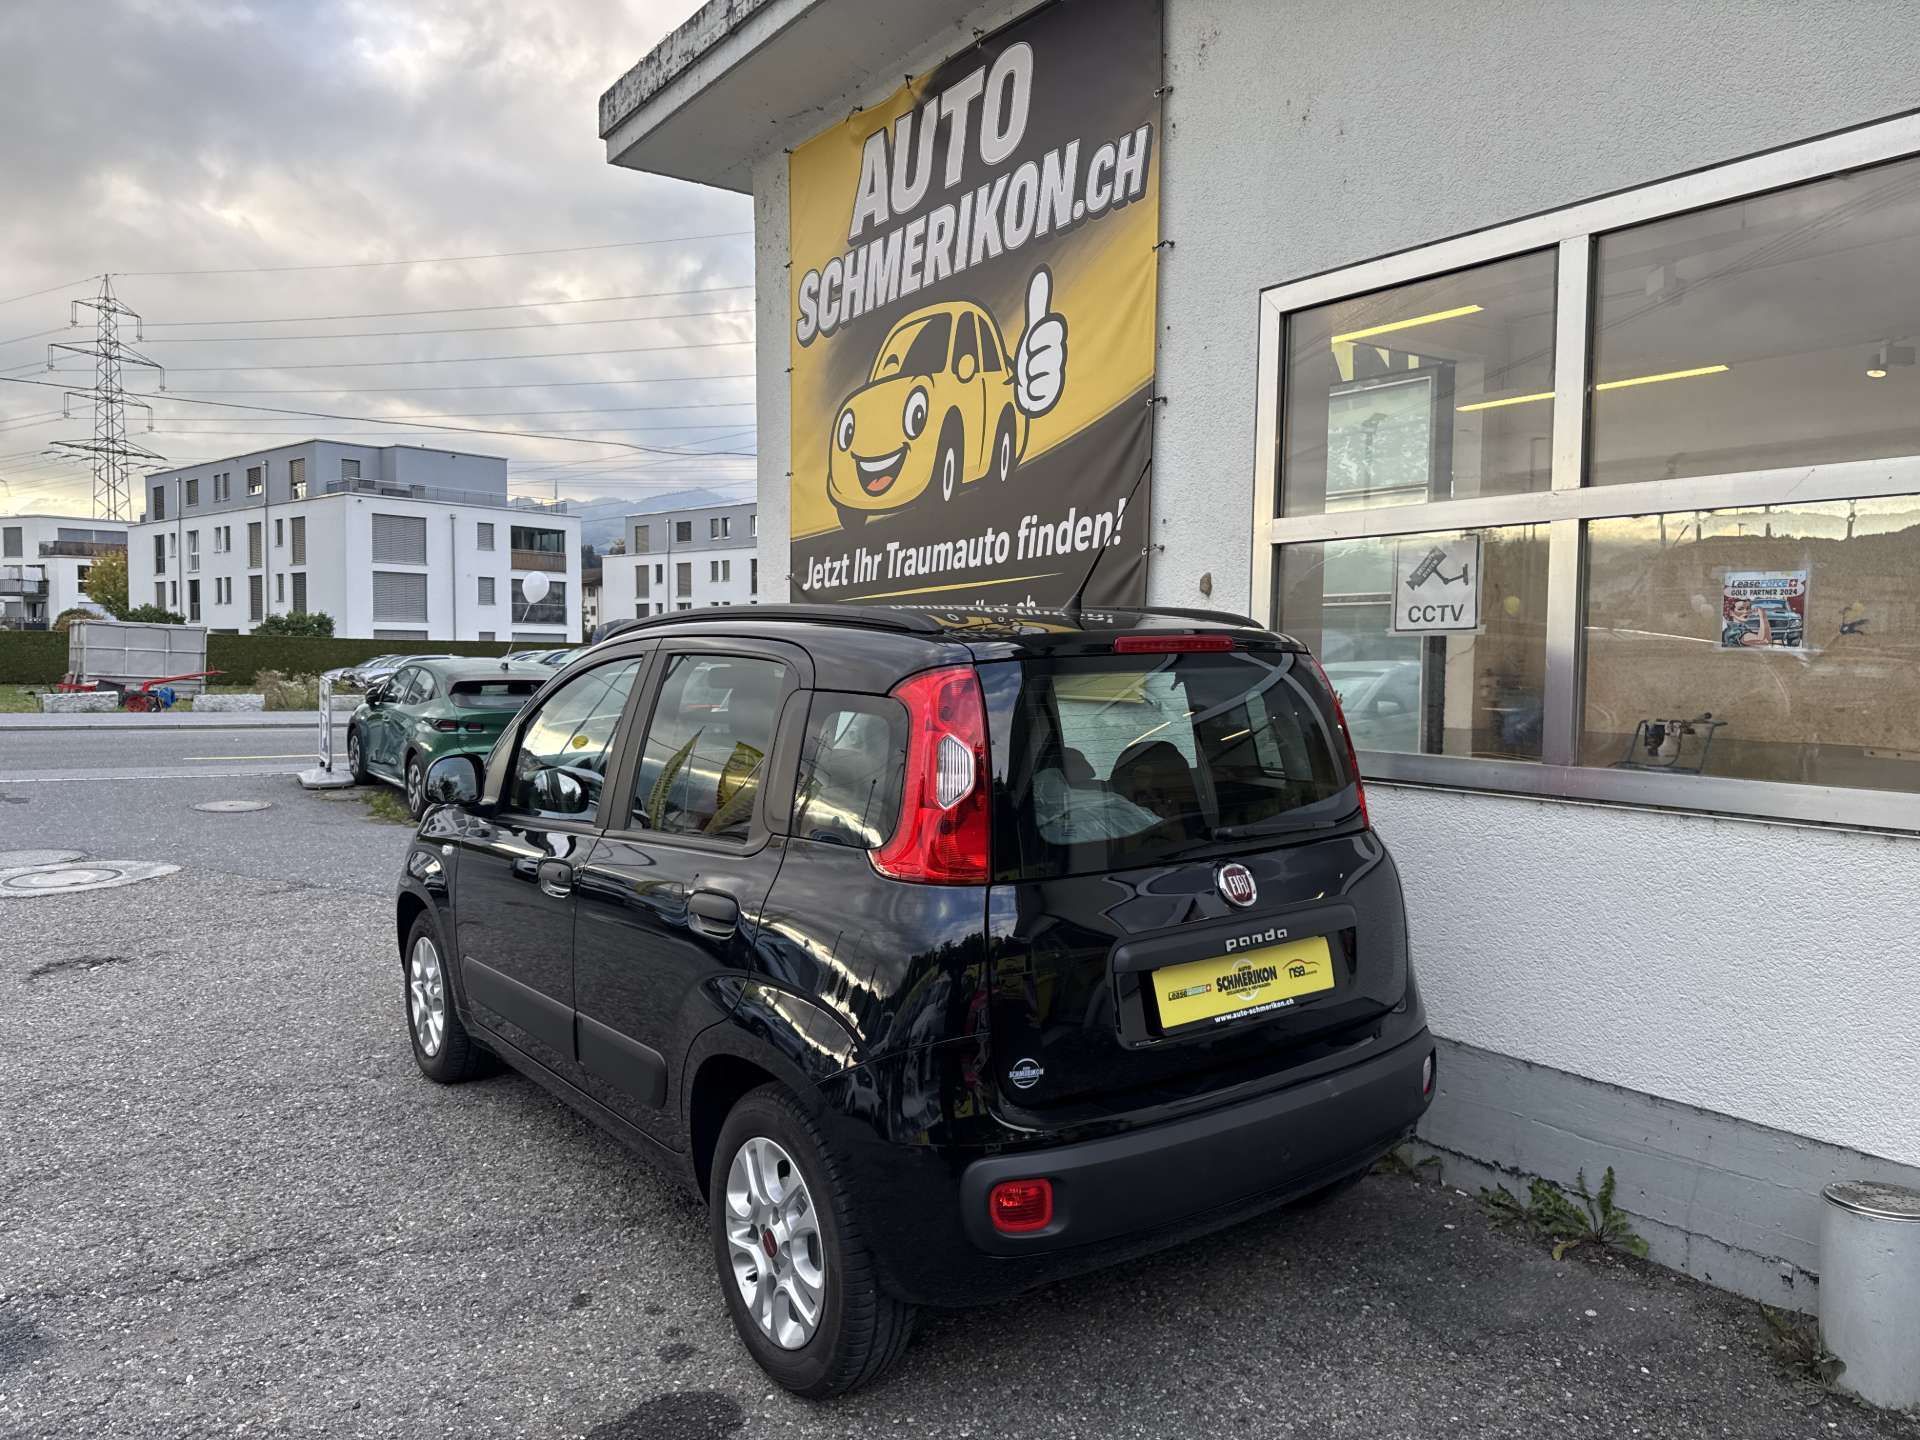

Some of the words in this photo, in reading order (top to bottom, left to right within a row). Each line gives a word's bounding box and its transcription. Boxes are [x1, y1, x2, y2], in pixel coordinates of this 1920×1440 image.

[848, 41, 1034, 242] AUTO
[796, 124, 1150, 344] SCHMERIKON.CH
[802, 554, 849, 591] Jetzt
[853, 548, 882, 583] Ihr
[886, 528, 1010, 579] Traumauto
[1016, 498, 1127, 561] finden!
[1780, 588, 1798, 596] 2024
[1408, 604, 1464, 623] CCTV
[1227, 874, 1251, 896] FIAT
[1225, 928, 1288, 951] panda
[1216, 965, 1278, 992] SCHMERIKON
[1214, 998, 1295, 1023] www.auto-schmerikon.ch
